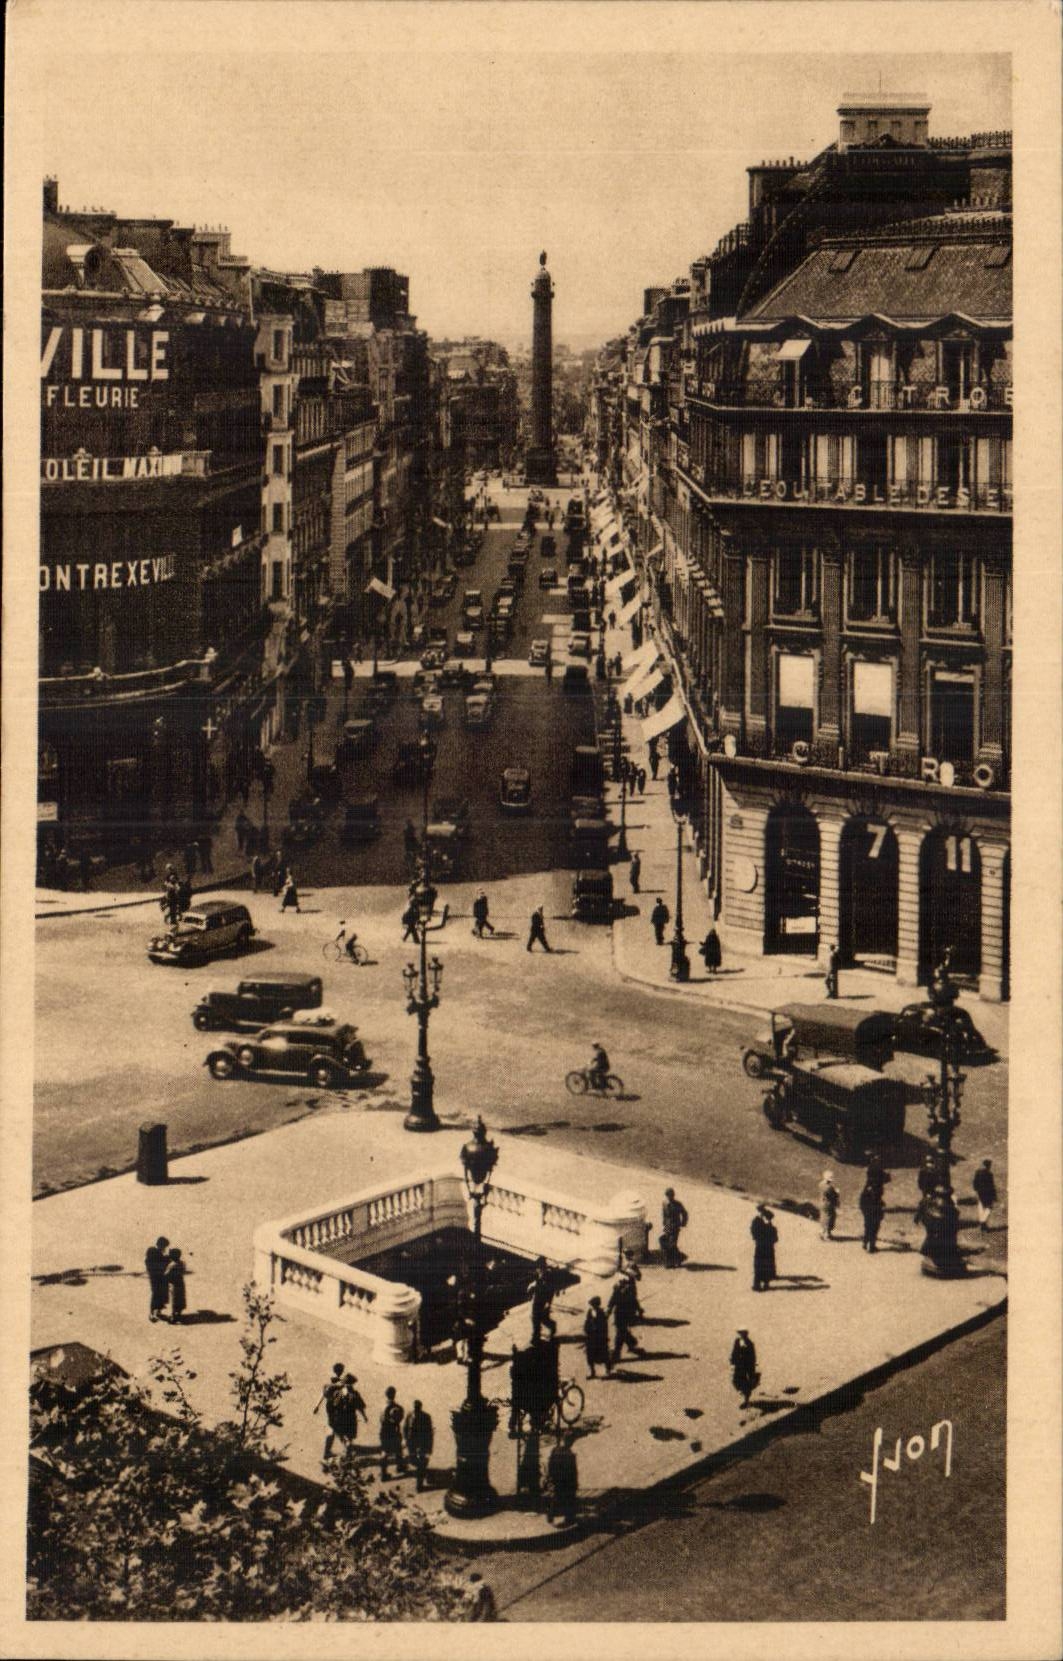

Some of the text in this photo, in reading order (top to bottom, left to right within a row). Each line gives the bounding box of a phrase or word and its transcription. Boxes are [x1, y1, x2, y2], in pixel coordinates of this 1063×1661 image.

[47, 385, 139, 408] FLEURIE
[867, 824, 887, 859] 7
[945, 836, 971, 873] 11
